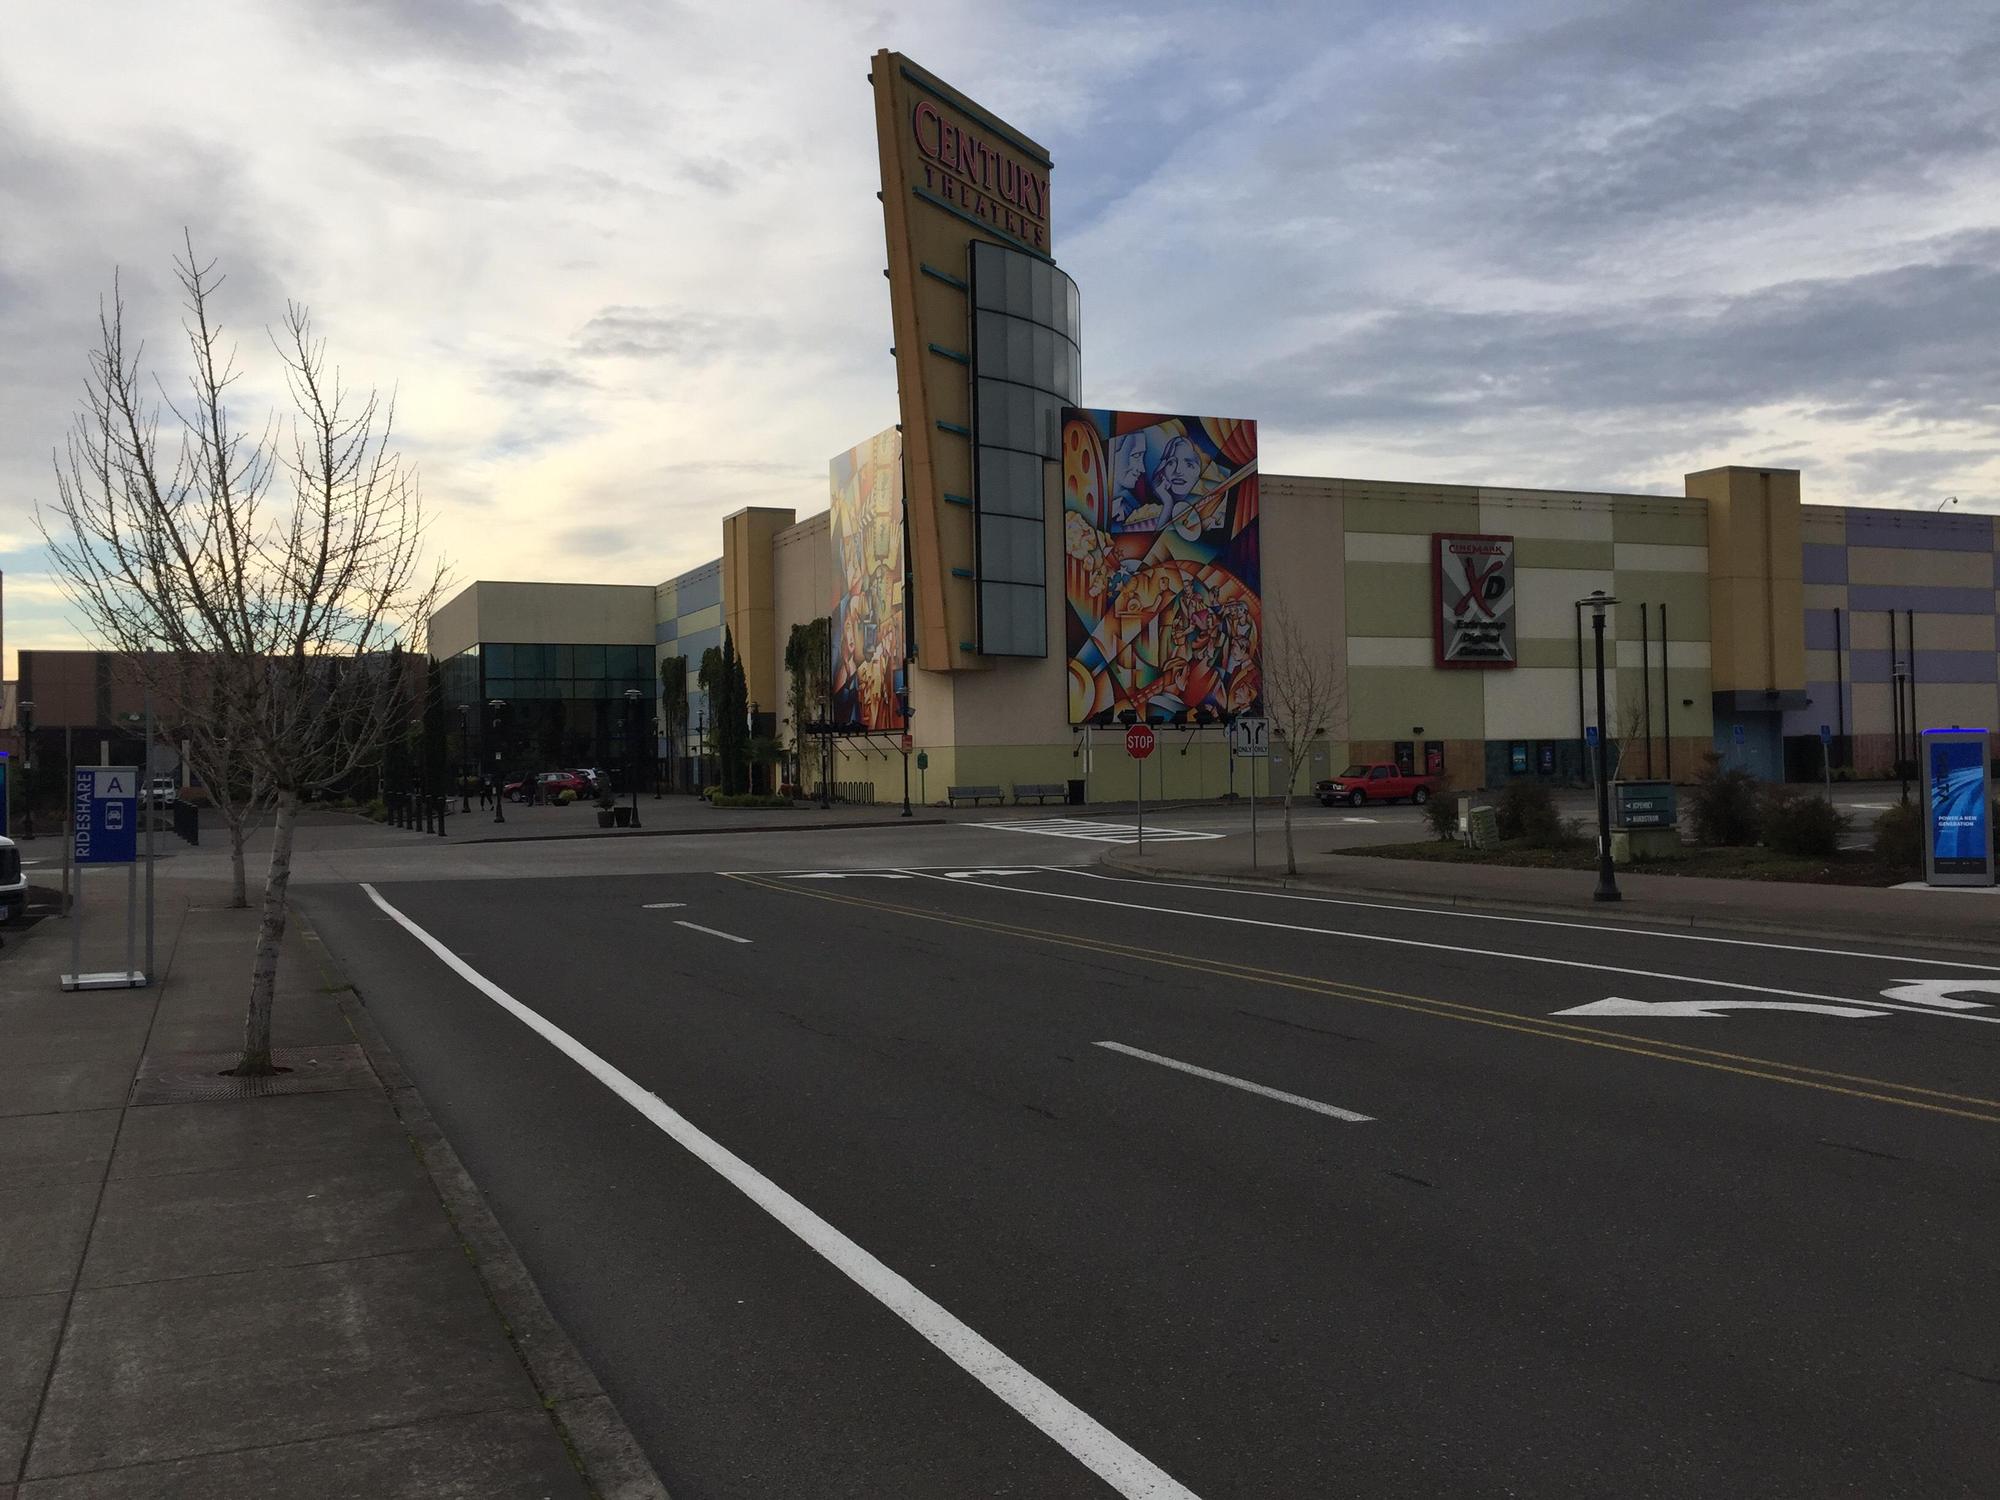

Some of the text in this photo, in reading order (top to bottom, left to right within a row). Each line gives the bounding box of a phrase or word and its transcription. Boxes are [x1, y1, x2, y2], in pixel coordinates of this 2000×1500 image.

[913, 101, 1050, 219] CENTURY
[925, 165, 1044, 247] THEATRES
[1127, 735, 1153, 748] STOP
[75, 774, 92, 857] RIDESHARE
[107, 777, 123, 793] A
